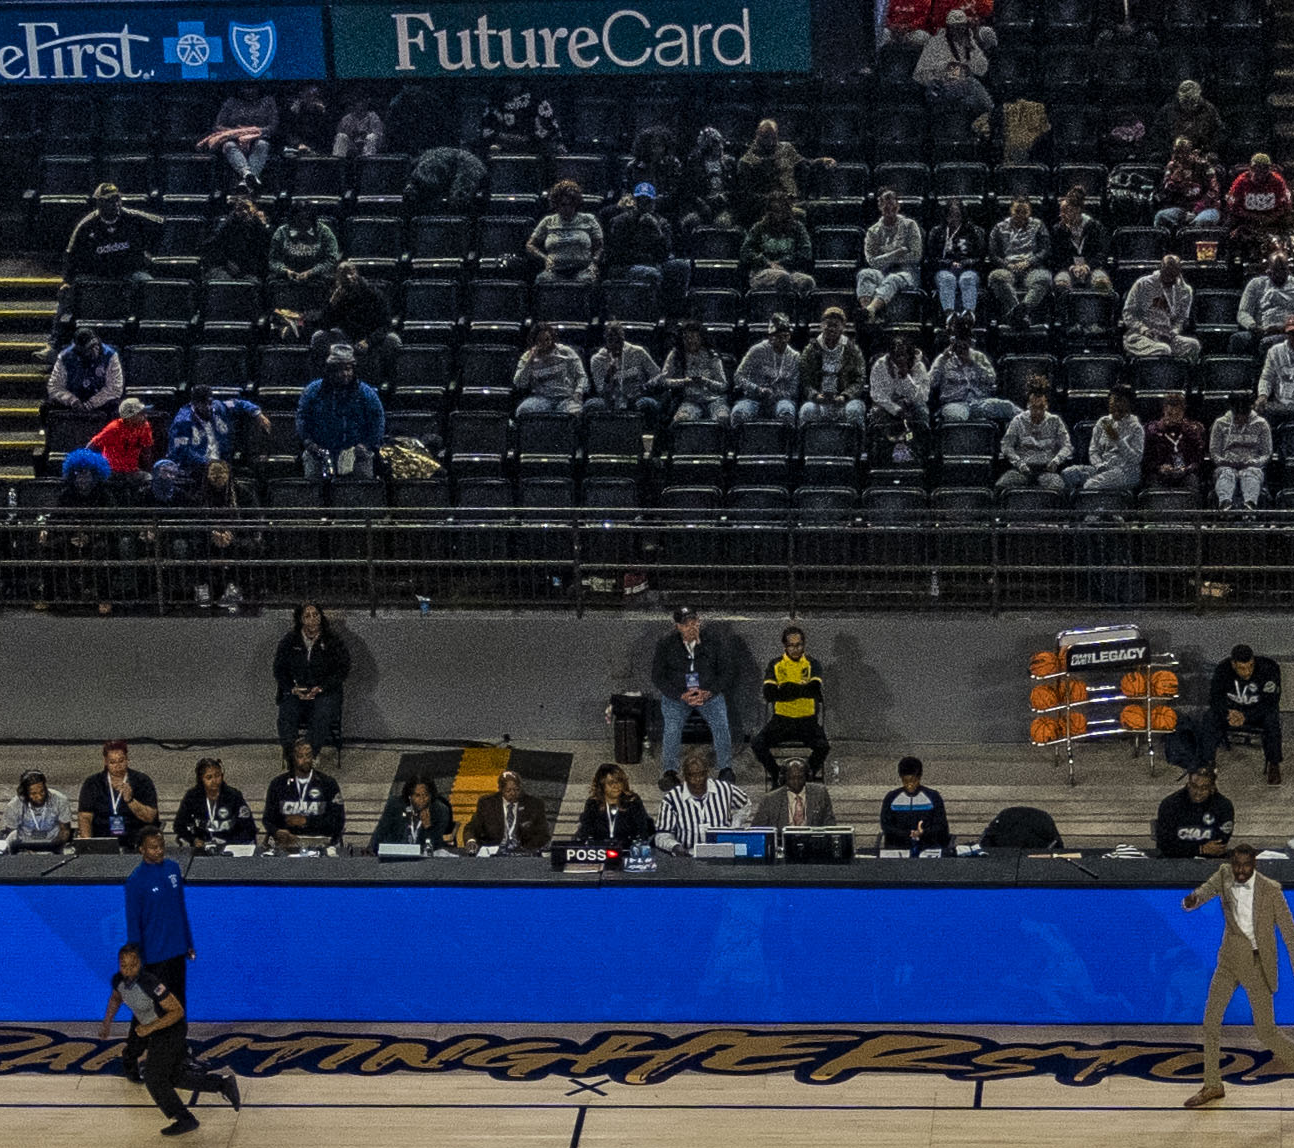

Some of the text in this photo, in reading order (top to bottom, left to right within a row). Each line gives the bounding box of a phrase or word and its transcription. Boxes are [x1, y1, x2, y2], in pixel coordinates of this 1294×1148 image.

[392, 7, 752, 71] FutureCard
[282, 801, 320, 816] CIAA
[566, 849, 607, 861] POSS
